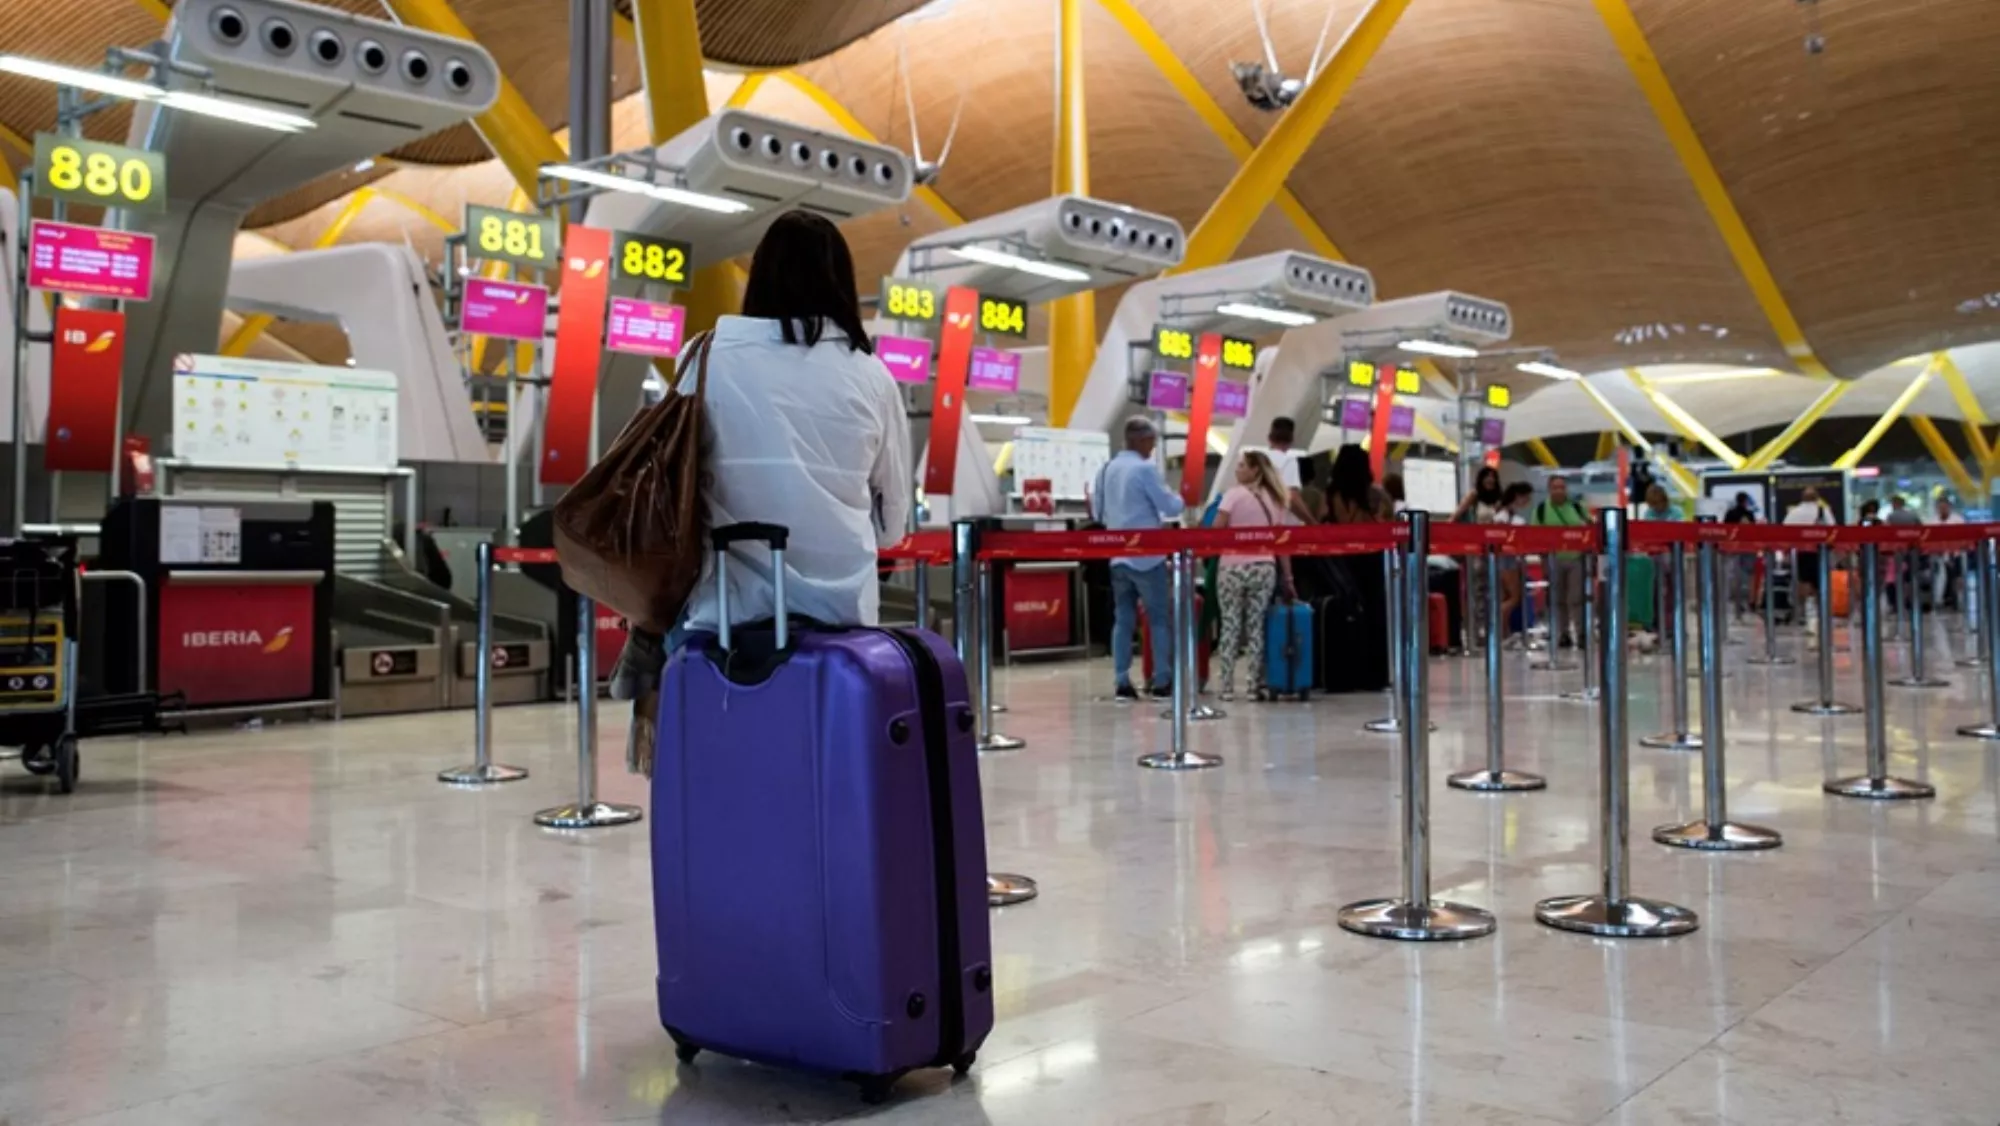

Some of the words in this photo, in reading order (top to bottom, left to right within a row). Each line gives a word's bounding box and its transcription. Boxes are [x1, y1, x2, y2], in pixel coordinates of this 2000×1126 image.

[49, 146, 152, 201] 880
[480, 215, 544, 259] 881
[623, 241, 684, 281] 882
[888, 285, 934, 319] 883
[981, 300, 1024, 333] 884
[64, 328, 87, 344] IB
[183, 629, 263, 648] IBERIA
